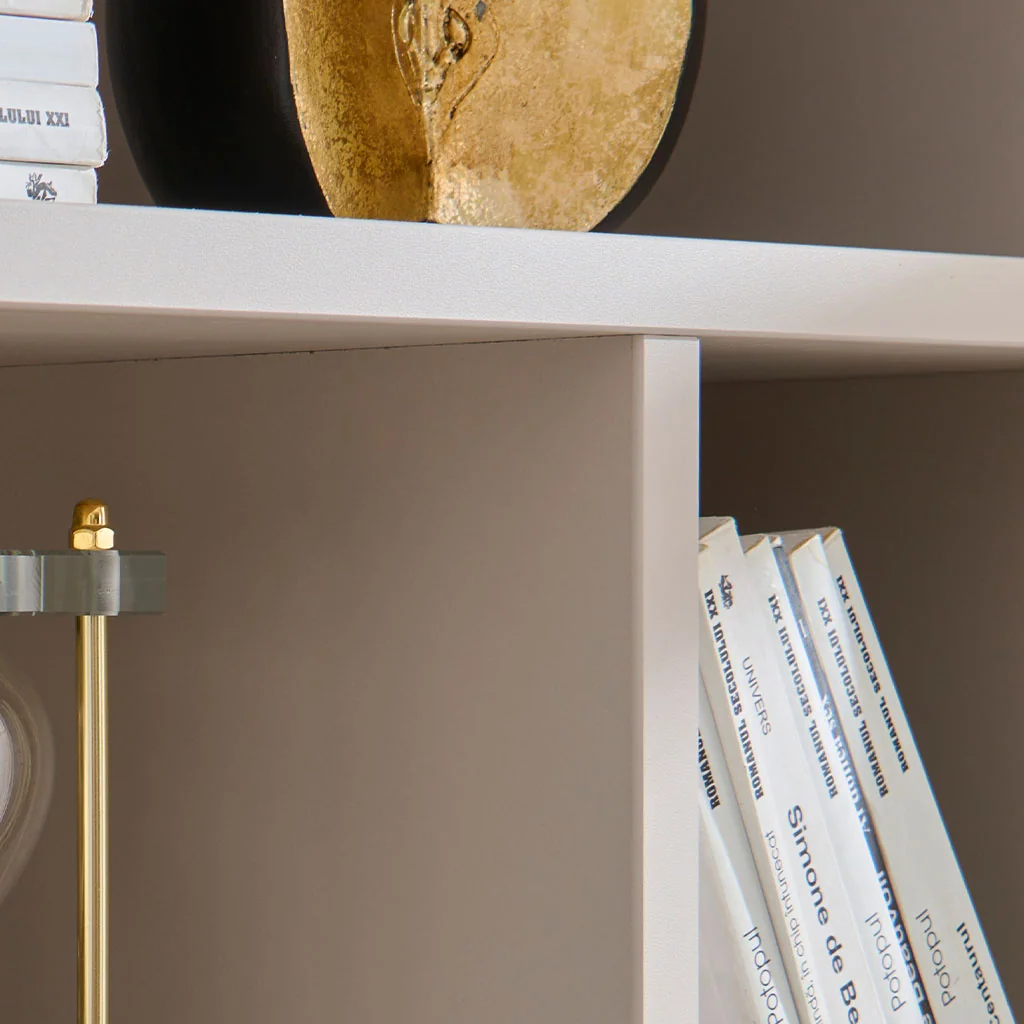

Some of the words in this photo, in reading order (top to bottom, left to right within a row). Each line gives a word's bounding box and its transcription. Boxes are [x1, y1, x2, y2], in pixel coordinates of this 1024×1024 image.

[46, 111, 70, 127] XXI
[704, 589, 719, 621] XXI
[768, 594, 783, 624] XXI
[817, 596, 833, 626] XXI
[836, 574, 850, 603] XXI
[712, 622, 743, 717] SECOLULUI
[778, 626, 813, 717] SECOLULUI
[827, 628, 862, 718] SECOLULUI
[846, 606, 881, 694] SECOLULUI
[738, 719, 764, 801] ROMANUL
[808, 719, 838, 800] ROMANUL
[858, 719, 889, 798] ROMANUL
[877, 696, 909, 774] ROMANUL
[742, 656, 772, 736] UNIVERS
[787, 804, 829, 926] Simone
[826, 935, 844, 974] de
[789, 917, 805, 958] chip
[865, 912, 906, 1012] Potopul
[916, 908, 956, 1007] Potopul
